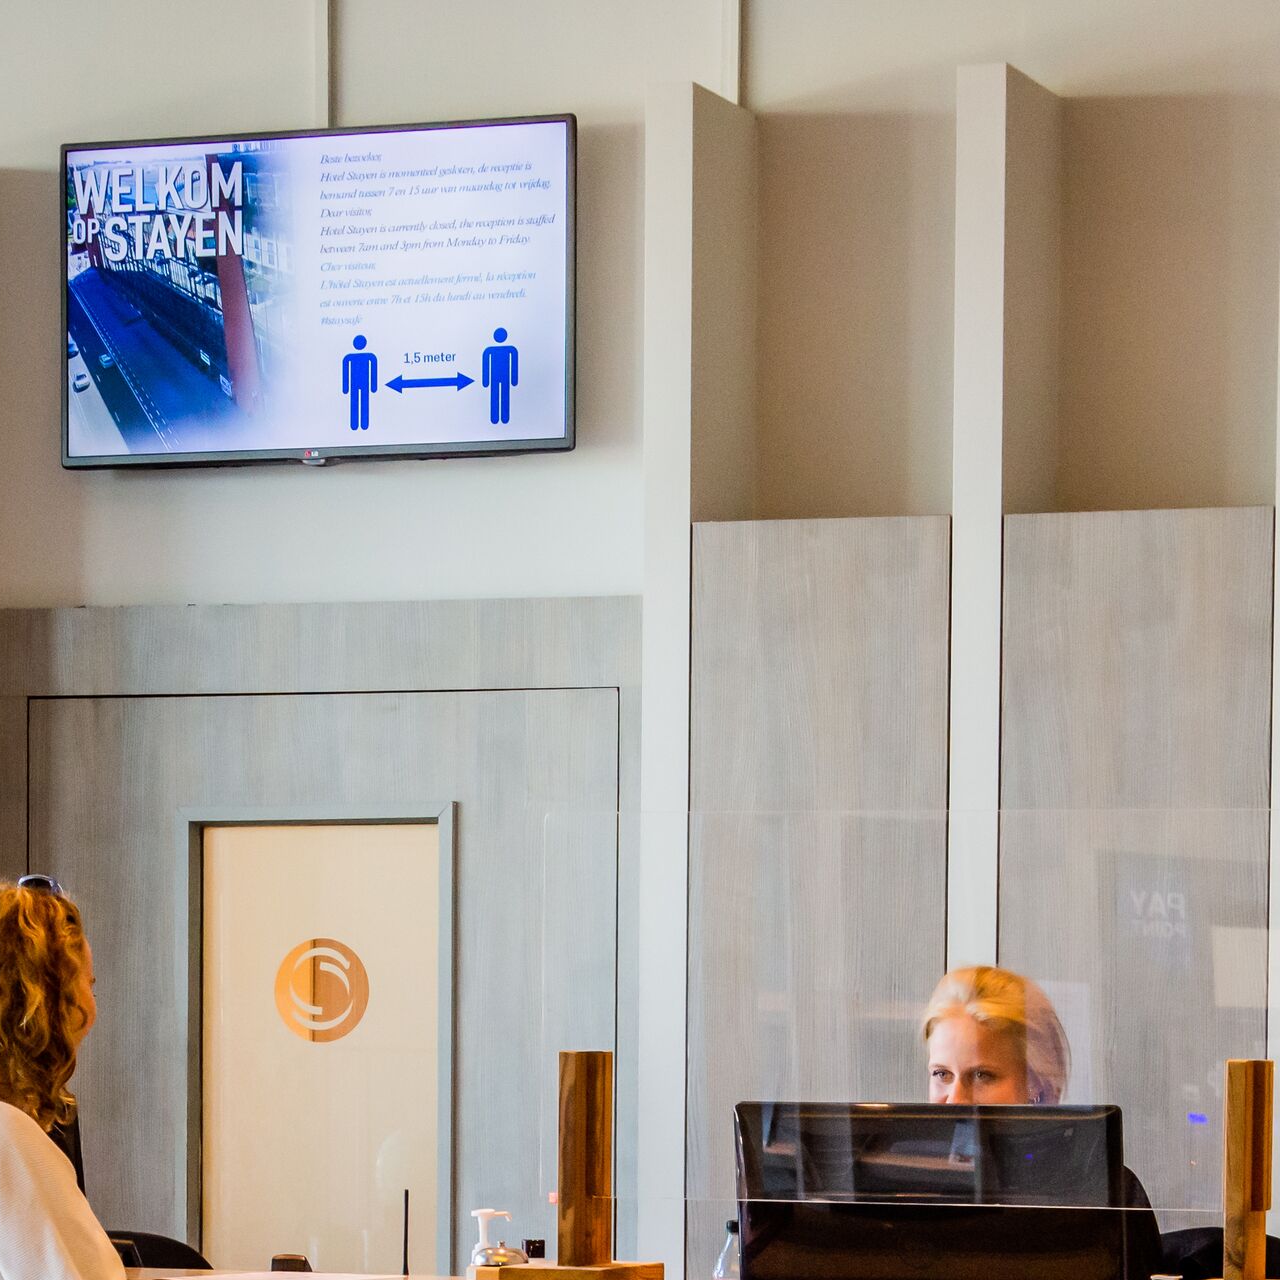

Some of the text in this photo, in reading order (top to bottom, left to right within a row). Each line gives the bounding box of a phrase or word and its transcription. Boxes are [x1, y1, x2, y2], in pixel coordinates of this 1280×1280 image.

[320, 171, 345, 182] Hotel
[346, 171, 377, 183] Stayen
[379, 169, 387, 178] is
[388, 166, 438, 178] momenteel
[477, 162, 489, 173] de
[524, 161, 533, 170] is
[73, 161, 243, 215] WELKOM
[320, 188, 357, 200] bemand
[358, 190, 386, 198] tussen
[388, 186, 395, 196] 7
[408, 185, 420, 195] 15
[458, 181, 503, 193] maandag
[504, 181, 516, 190] tot
[73, 218, 99, 244] OP
[104, 210, 243, 262] STAYEN
[320, 214, 556, 237] Hotel Stayen is currently closed, the reception is staffed
[320, 244, 355, 254] between
[358, 242, 378, 252] 7am
[379, 241, 399, 250] and
[400, 240, 421, 252] 3pm
[421, 239, 444, 251] from
[446, 236, 486, 248] Monday
[487, 237, 497, 245] to
[352, 279, 384, 290] Stayen
[384, 278, 398, 287] est
[486, 271, 494, 281] la
[403, 352, 456, 364] 1,5 meter
